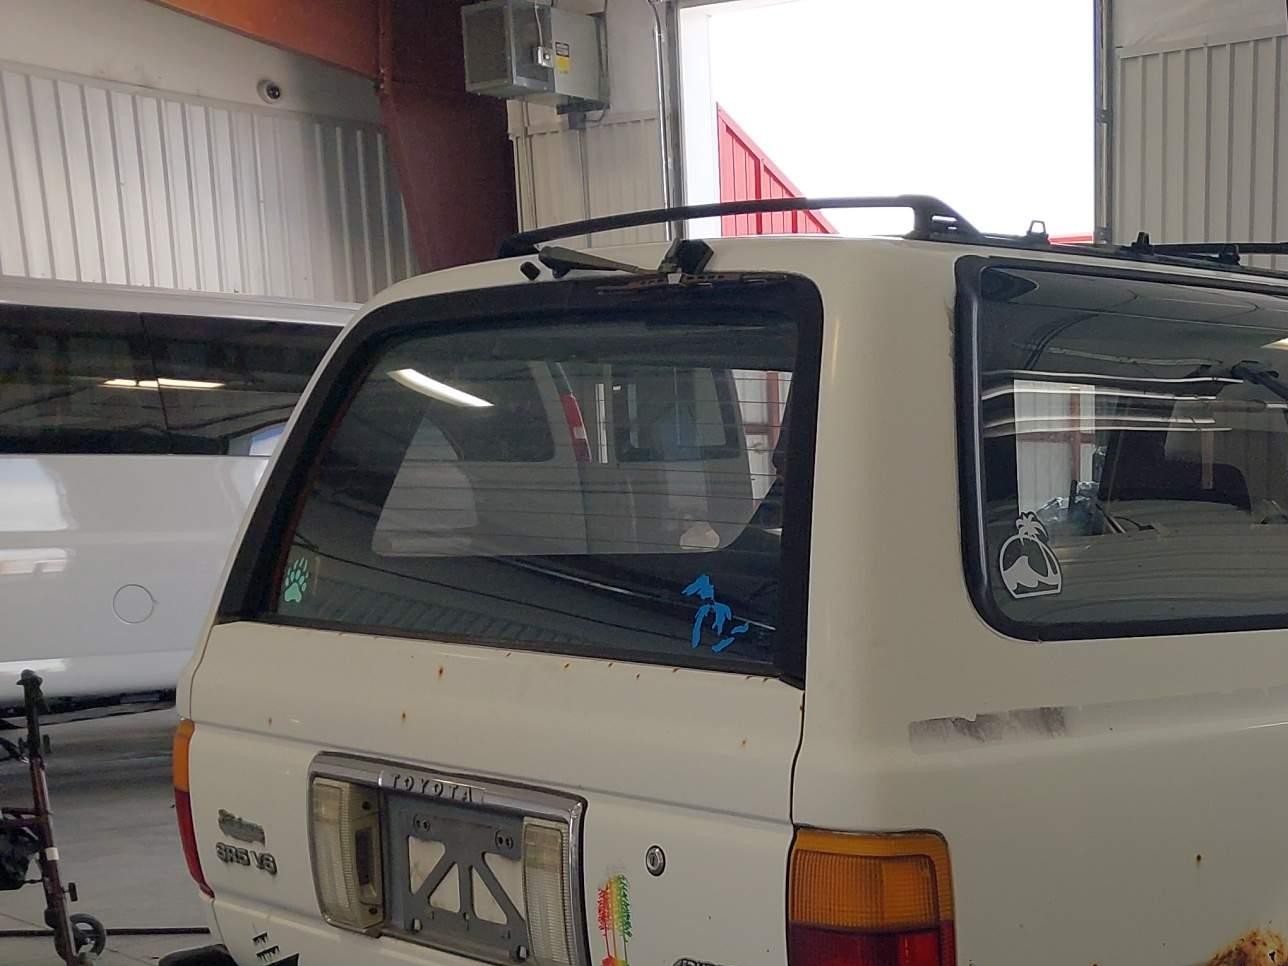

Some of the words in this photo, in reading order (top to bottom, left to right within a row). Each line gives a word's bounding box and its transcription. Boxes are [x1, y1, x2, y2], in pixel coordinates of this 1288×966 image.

[392, 773, 474, 802] TOYOTA
[216, 841, 250, 866] SR5
[250, 850, 277, 875] V6
